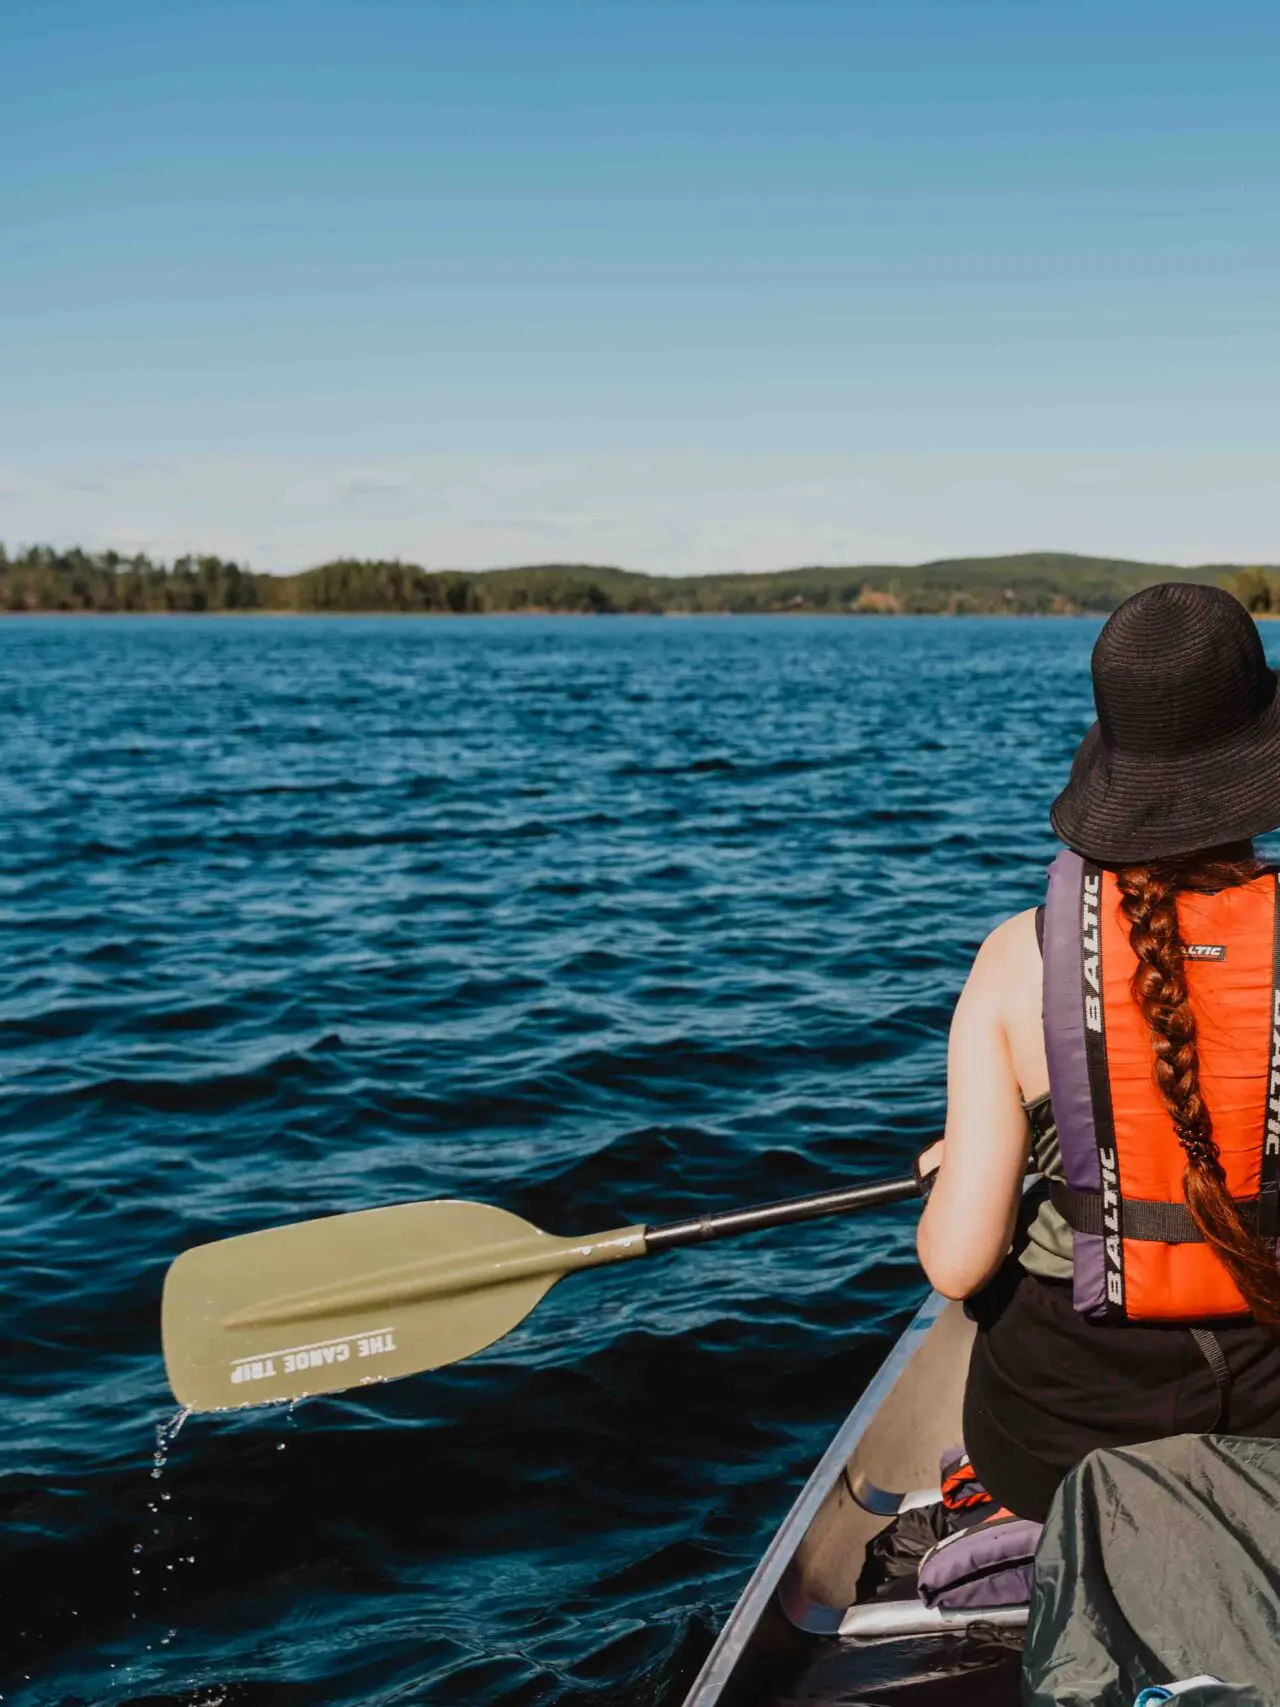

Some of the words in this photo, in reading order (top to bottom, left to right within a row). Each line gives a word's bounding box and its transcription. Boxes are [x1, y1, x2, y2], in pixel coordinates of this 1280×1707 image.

[1083, 875, 1102, 1033] BALTIC
[1100, 1148, 1123, 1306] BALTIC
[283, 1343, 350, 1374] CANOE
[357, 1333, 397, 1358] THE
[230, 1358, 277, 1384] TRIP
